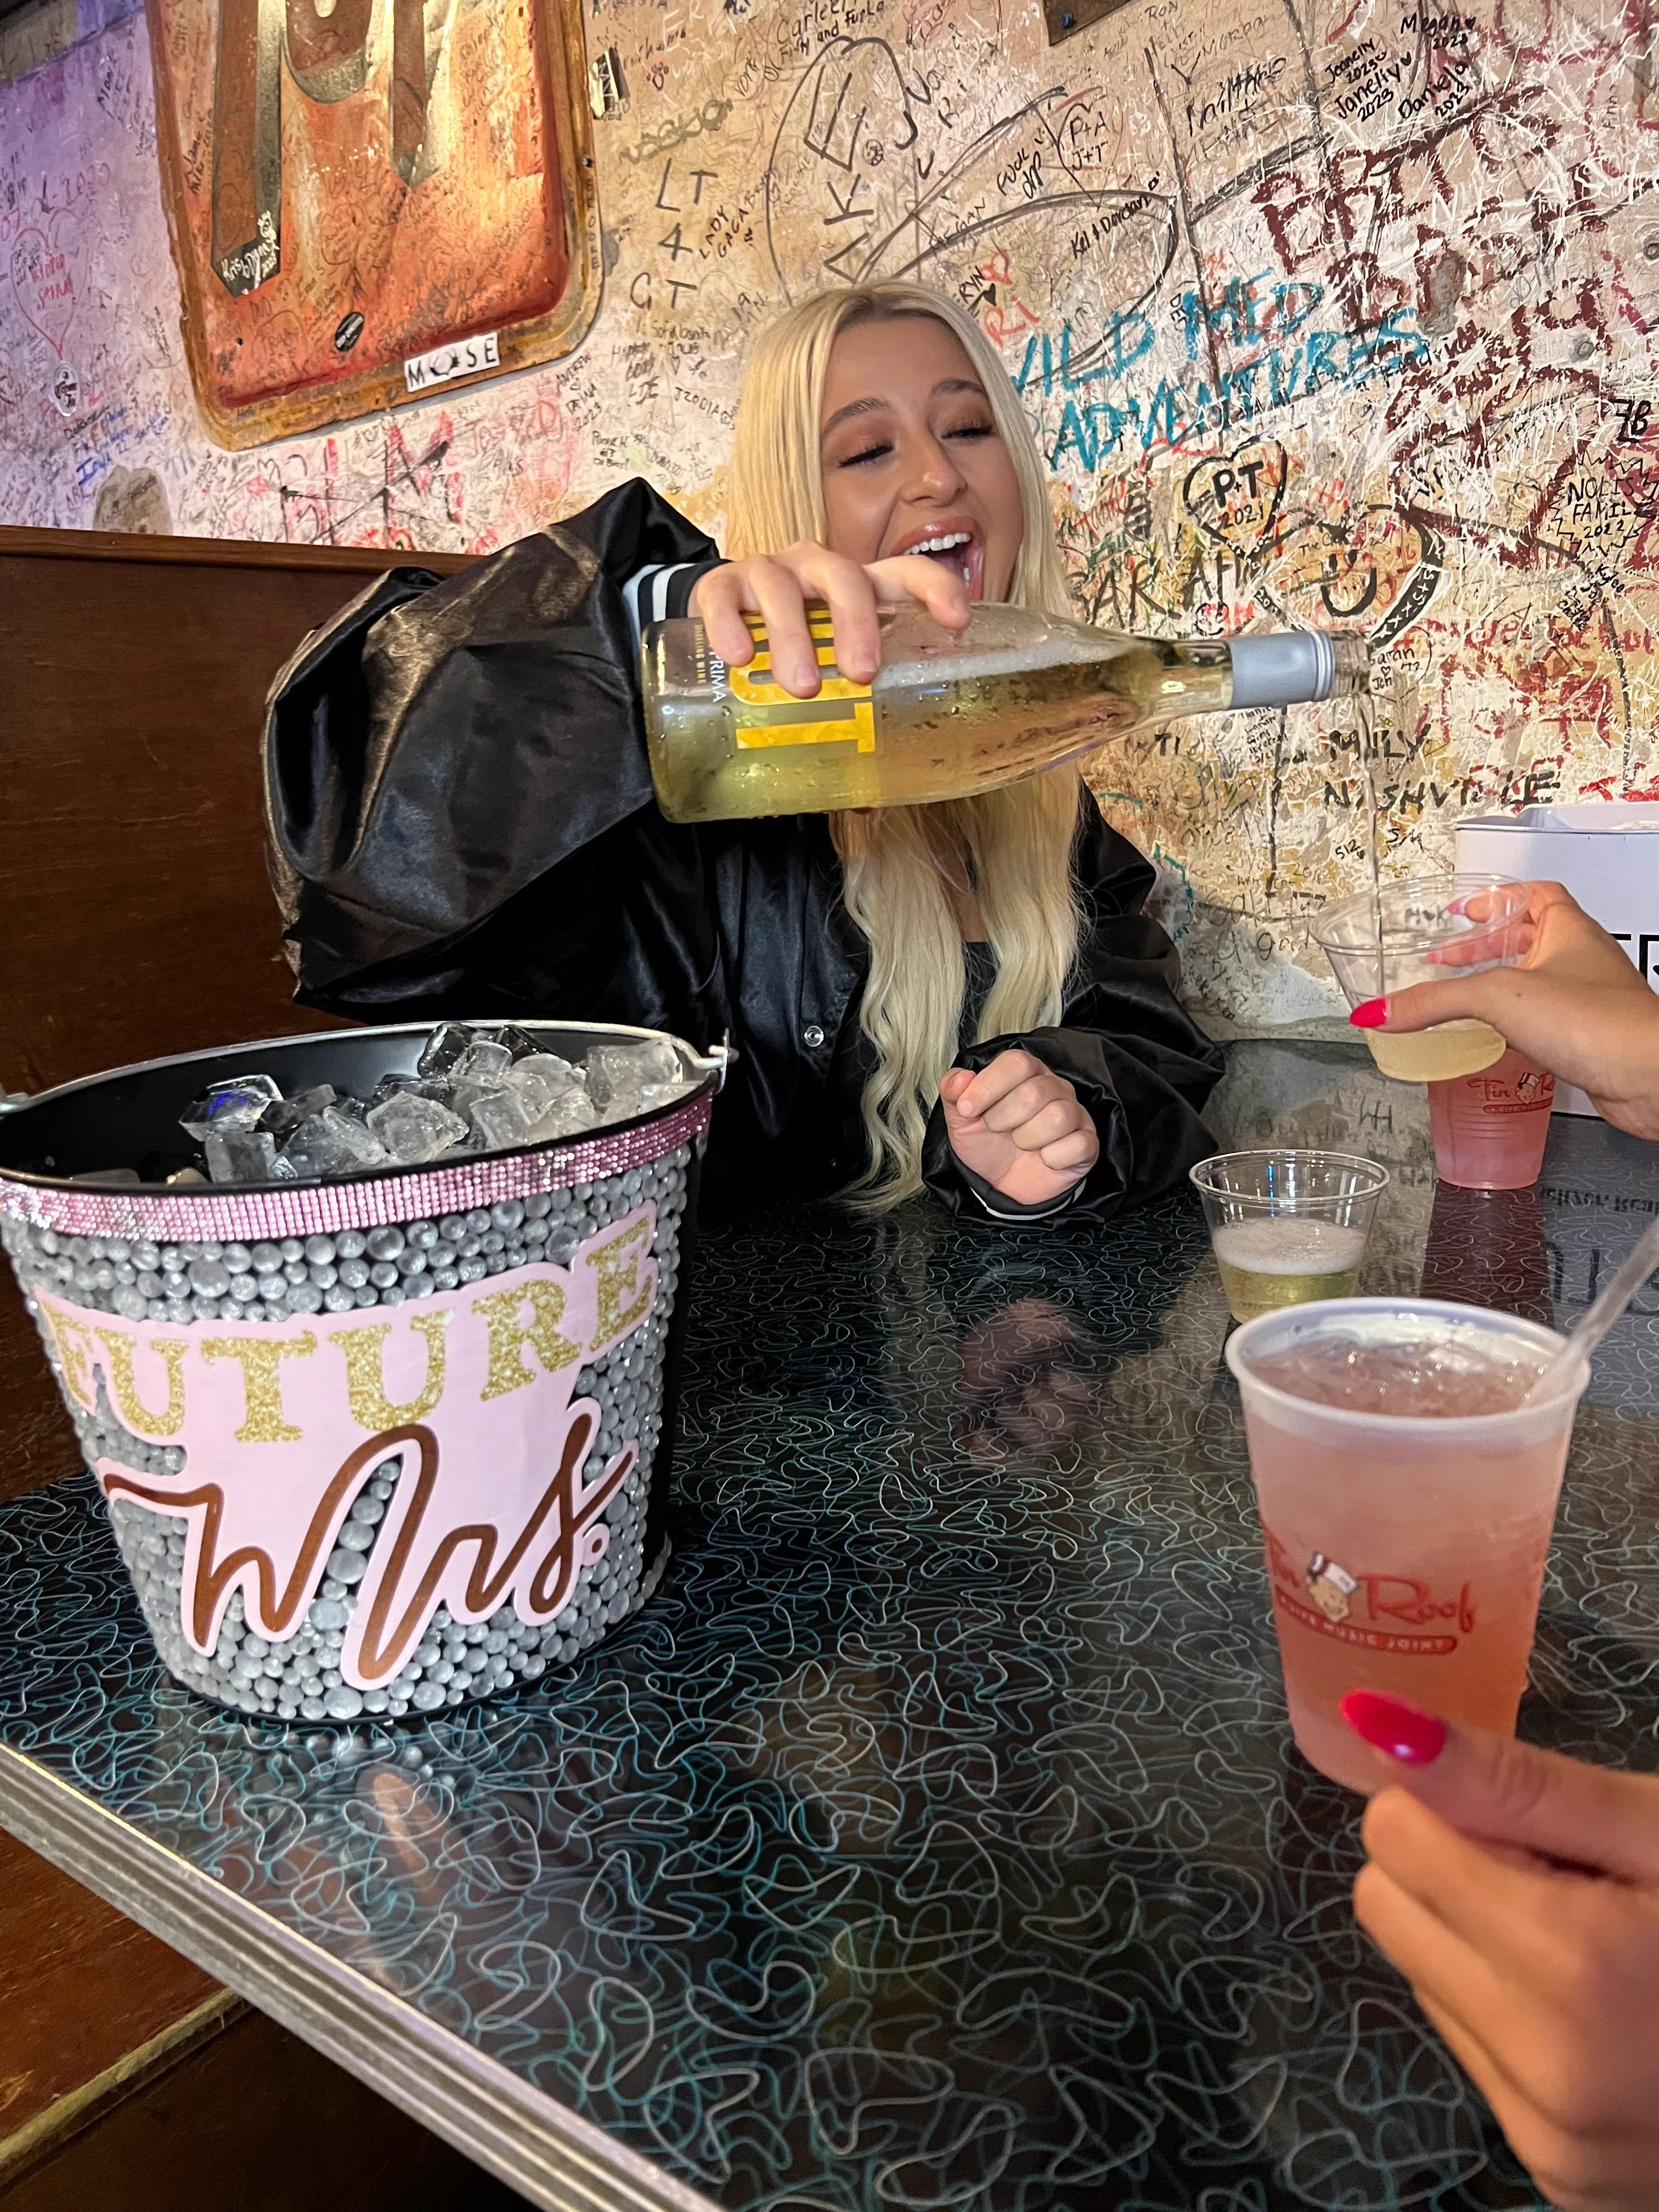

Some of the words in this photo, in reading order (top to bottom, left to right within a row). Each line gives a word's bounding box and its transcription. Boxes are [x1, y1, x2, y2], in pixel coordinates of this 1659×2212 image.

[1345, 59, 1379, 84] 2023
[1357, 89, 1395, 122] 2023
[655, 157, 718, 213] LT
[699, 204, 729, 260] LADY
[38, 1216, 654, 1444] FUTURE
[102, 1411, 635, 1681] Mrs.
[1359, 1573, 1477, 1633] Roof
